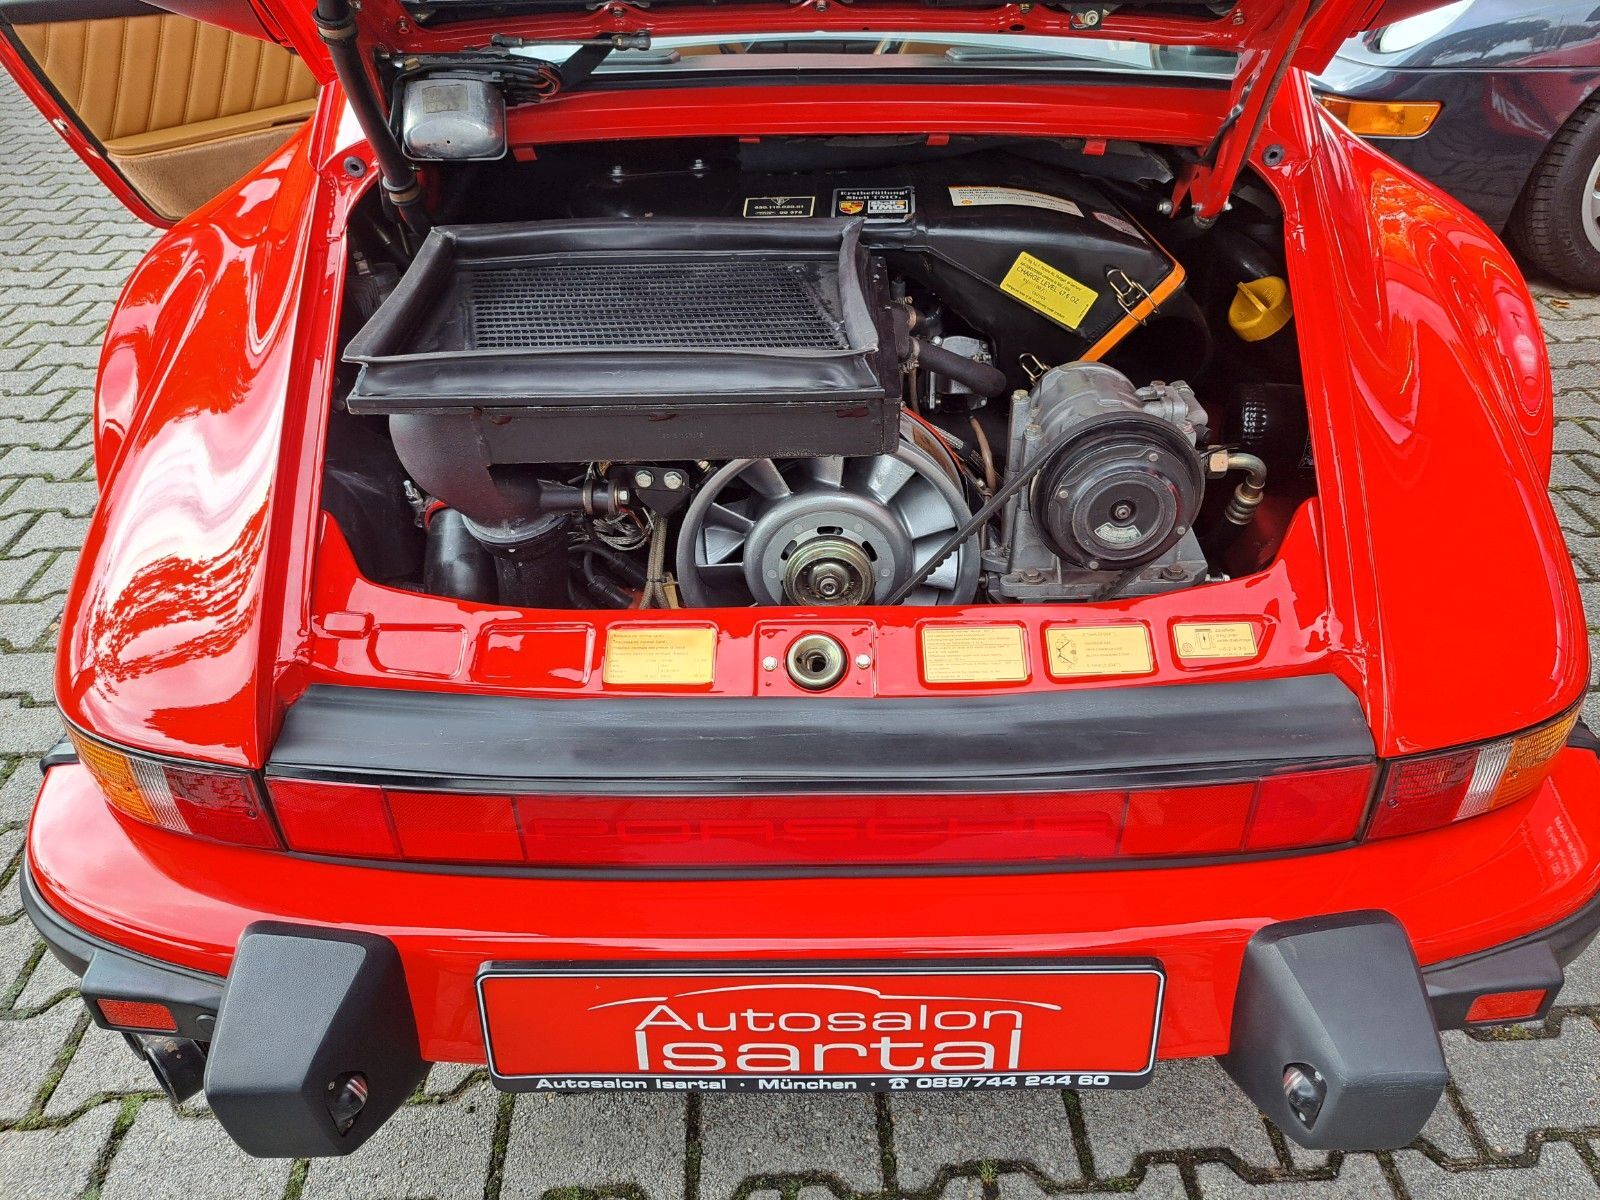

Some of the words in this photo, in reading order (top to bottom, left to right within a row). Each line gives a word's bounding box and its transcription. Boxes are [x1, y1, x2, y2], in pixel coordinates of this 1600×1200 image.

[1016, 266, 1041, 282] CHARGE
[1041, 279, 1057, 292] LEVEL
[635, 1004, 1023, 1032] Autosalon
[634, 1029, 1022, 1072] Isartal
[535, 1078, 648, 1089] Autosalon
[655, 1078, 727, 1090] Isartal
[758, 1078, 857, 1090] München
[916, 1076, 1018, 1090] 089/744
[1024, 1075, 1072, 1087] 244
[1078, 1075, 1110, 1086] 60
